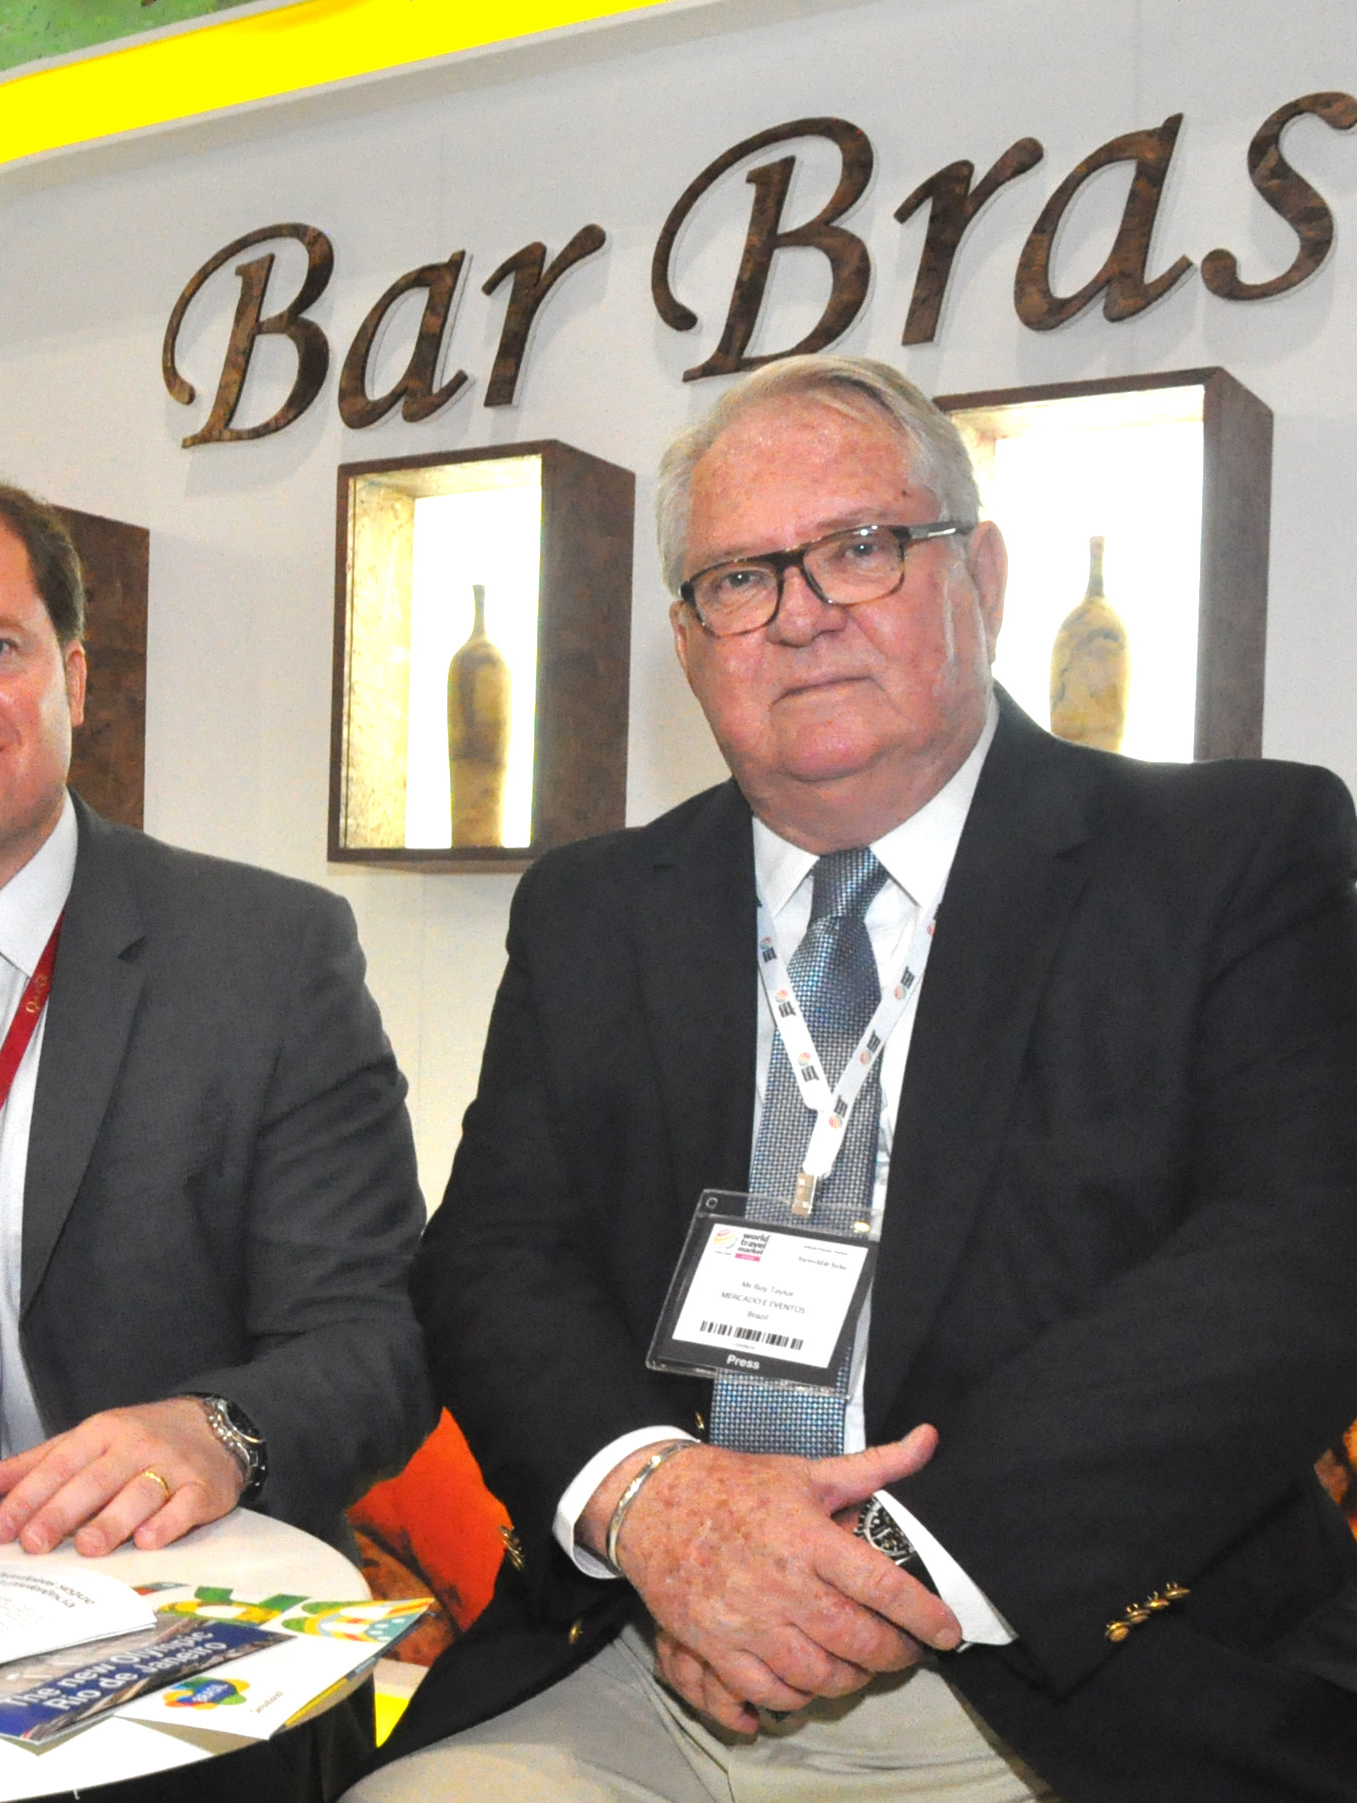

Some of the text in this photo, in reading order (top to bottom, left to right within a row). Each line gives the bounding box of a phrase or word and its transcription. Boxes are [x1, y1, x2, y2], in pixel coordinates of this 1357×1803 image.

[162, 92, 1357, 449] Bar Bras
[726, 1354, 760, 1370] Press
[43, 1642, 227, 1711] Rio de Janeiro
[58, 1663, 116, 1688] new
[110, 1631, 213, 1665] Olympic
